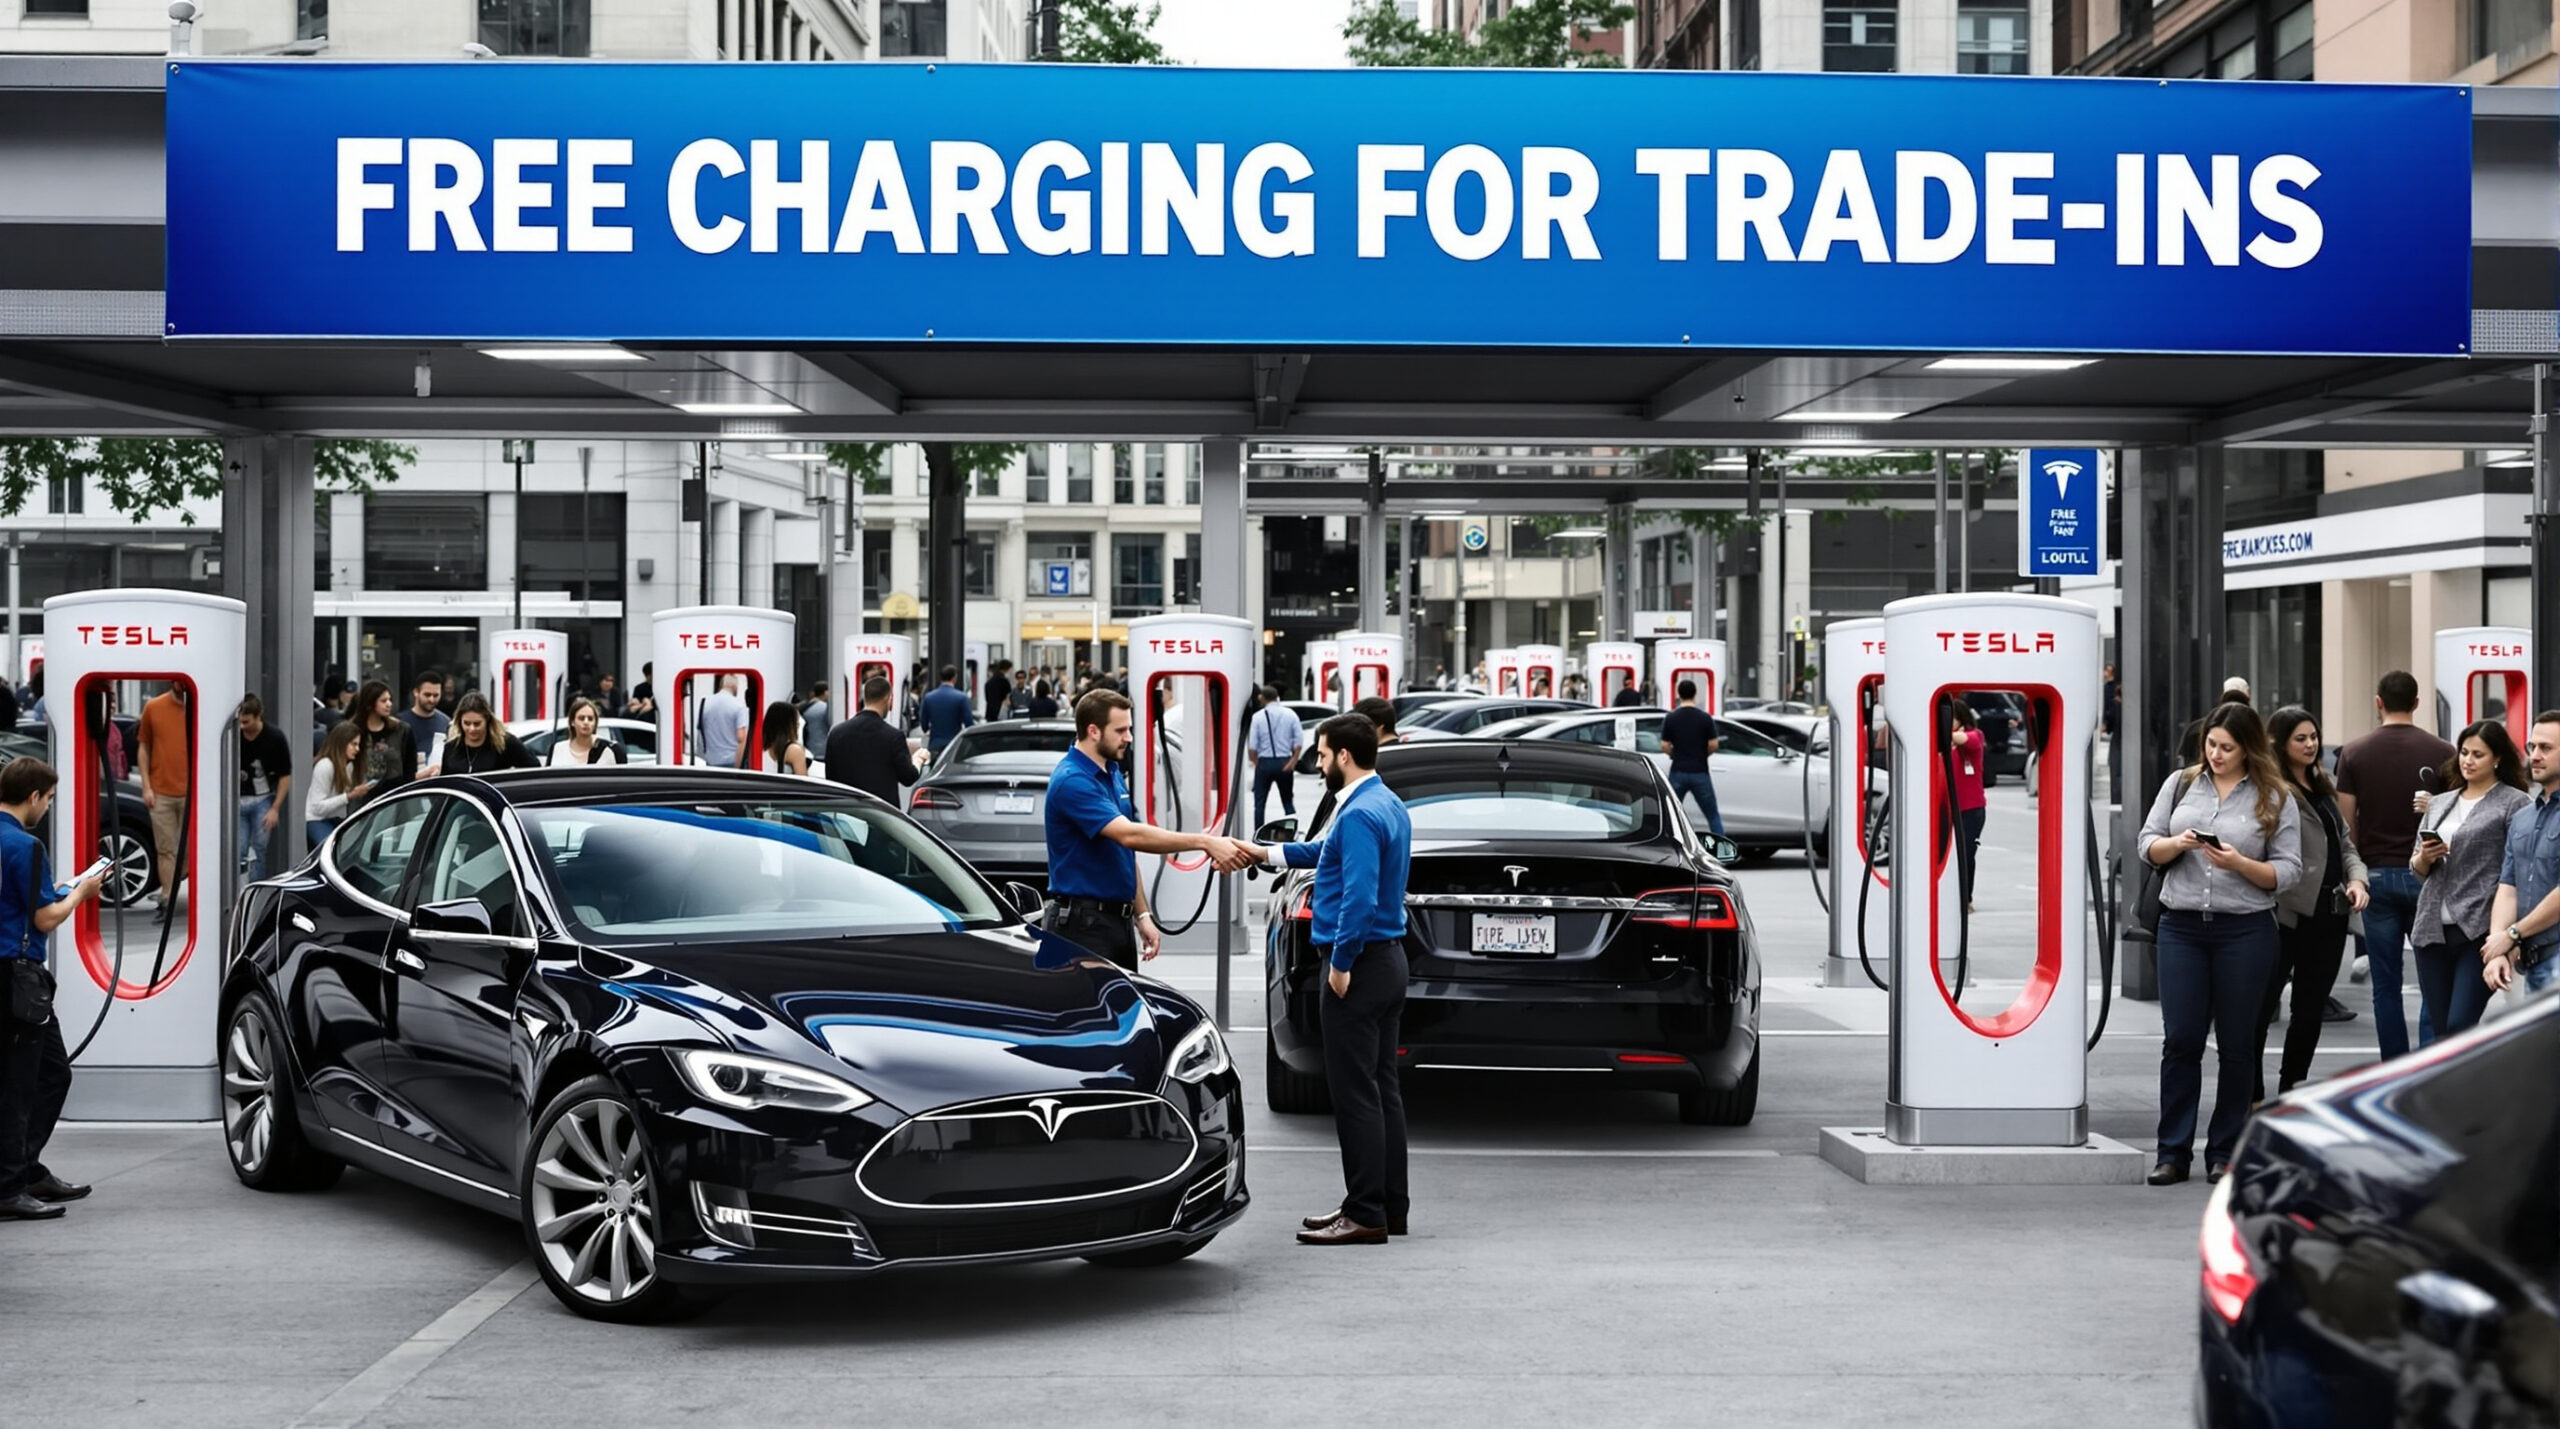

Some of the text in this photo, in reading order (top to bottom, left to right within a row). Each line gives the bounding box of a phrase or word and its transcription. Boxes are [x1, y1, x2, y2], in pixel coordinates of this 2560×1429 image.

[337, 138, 2324, 268] FREE CHARGING FOR TRADE-INS
[76, 625, 189, 647] TESLA
[679, 633, 761, 651] TESLA
[1935, 631, 2056, 654] TESLA
[1148, 639, 1225, 655] TESLA
[2468, 644, 2524, 657] TESLA
